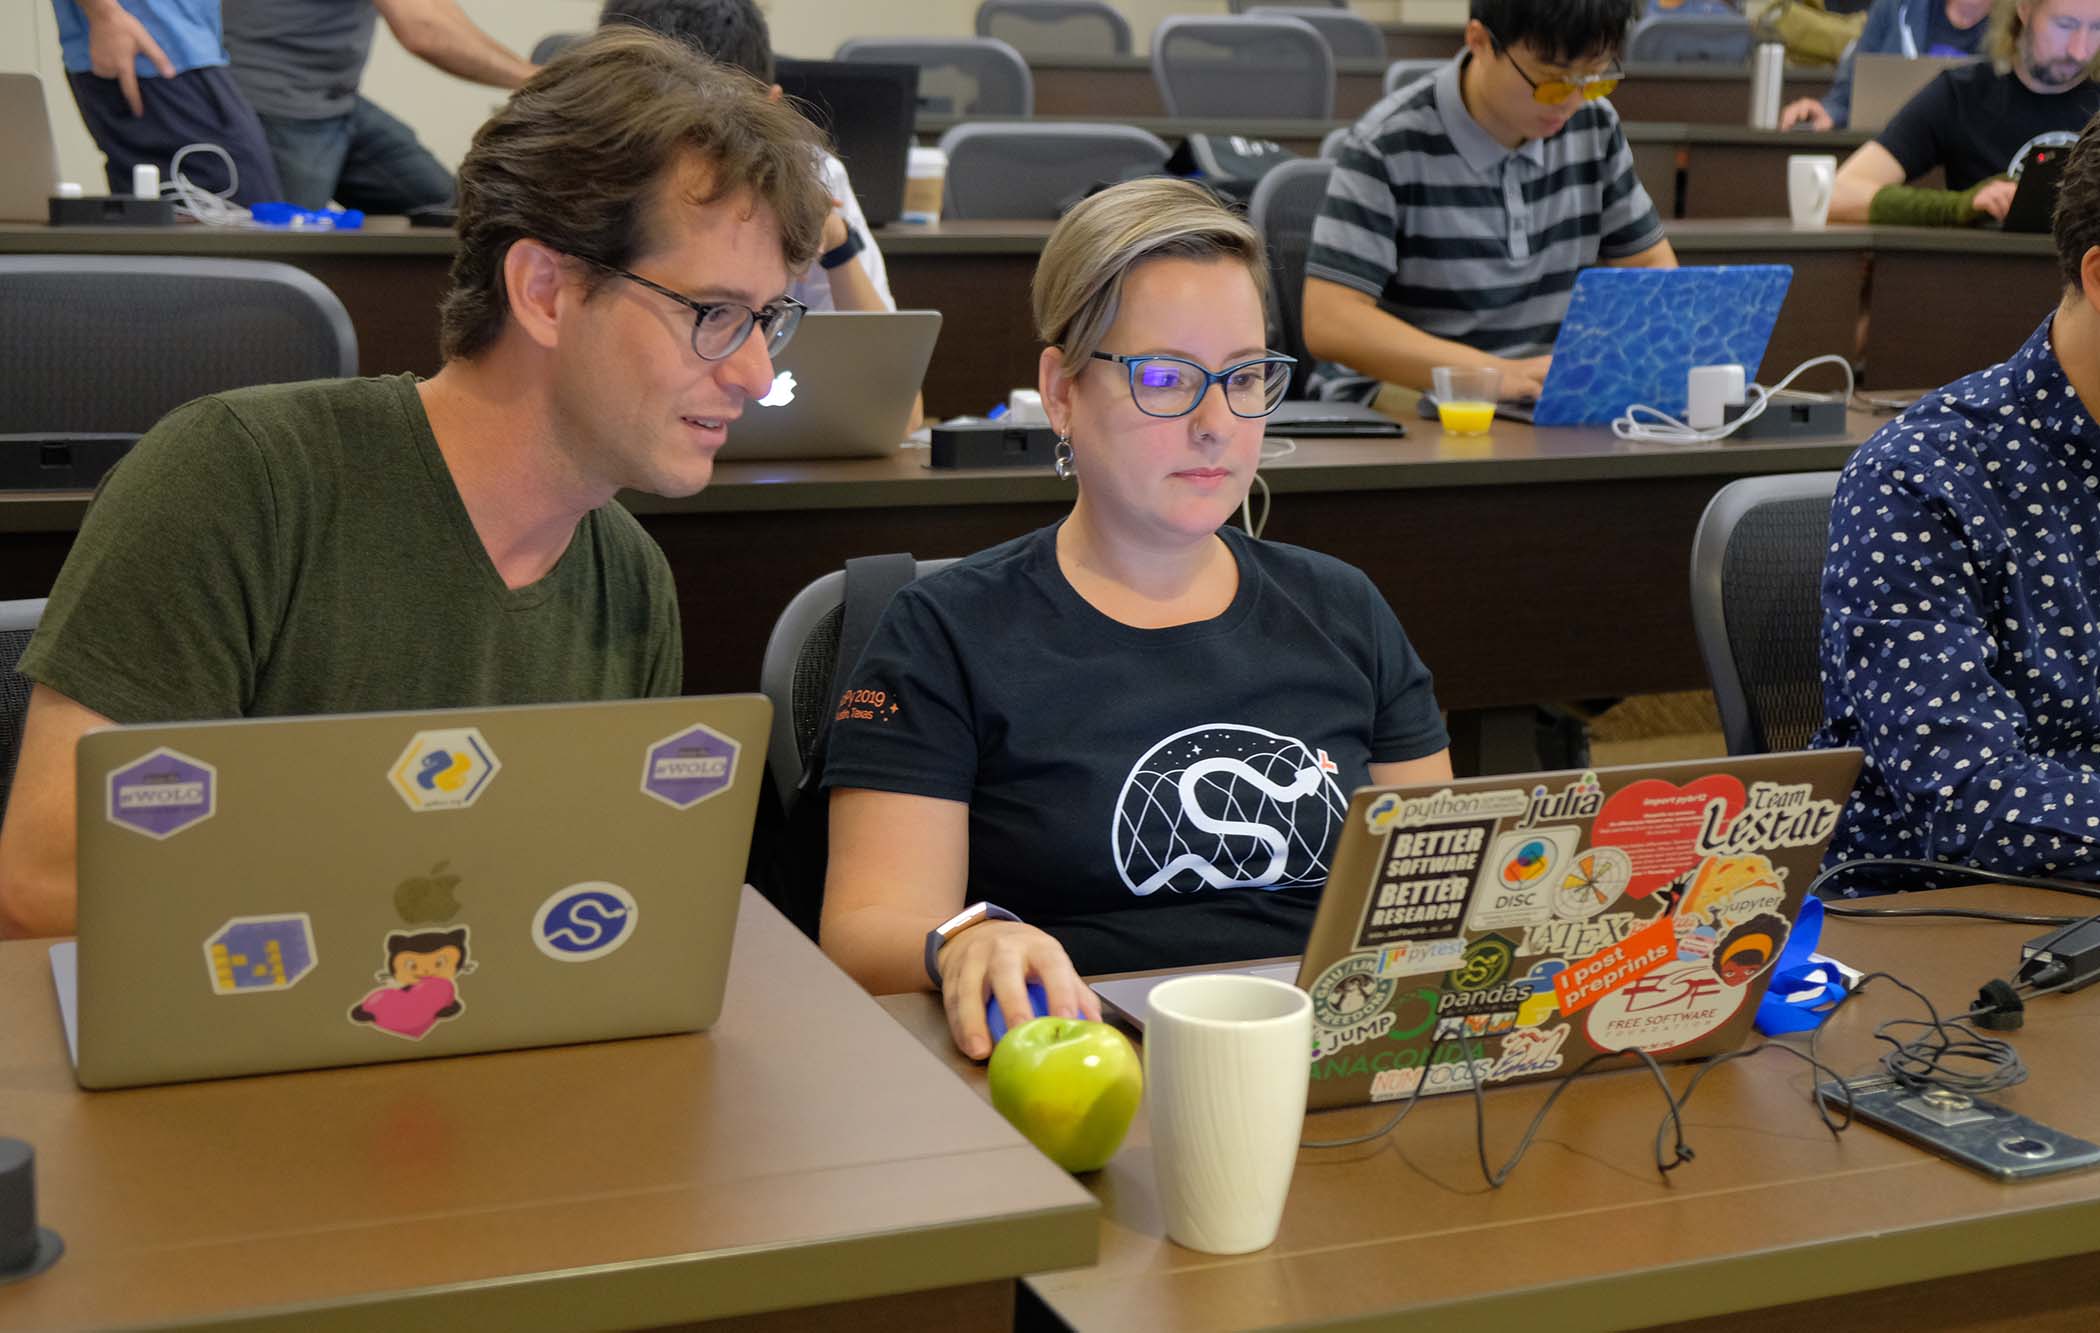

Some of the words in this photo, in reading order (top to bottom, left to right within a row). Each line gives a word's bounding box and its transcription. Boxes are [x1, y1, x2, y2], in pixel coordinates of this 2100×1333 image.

[1403, 794, 1479, 821] python
[1519, 784, 1601, 829] julia
[1755, 787, 1806, 811] Team
[1701, 803, 1836, 850] Lestat
[1393, 828, 1485, 857] BETTER
[1387, 854, 1478, 877] SOFTWARE
[1378, 878, 1469, 907] BETTER
[1495, 893, 1537, 910] DISC
[1373, 903, 1462, 926] RESEARCH
[1720, 896, 1781, 915] jupyter
[1408, 940, 1465, 960] pytest
[1560, 974, 1570, 988] I
[1574, 945, 1626, 984] post
[1563, 943, 1669, 1009] preprints
[1439, 986, 1531, 1009] pandas
[1607, 1017, 1643, 1031] FREE
[1645, 1008, 1718, 1026] SOFTWARE
[1326, 1015, 1391, 1051] JUMP
